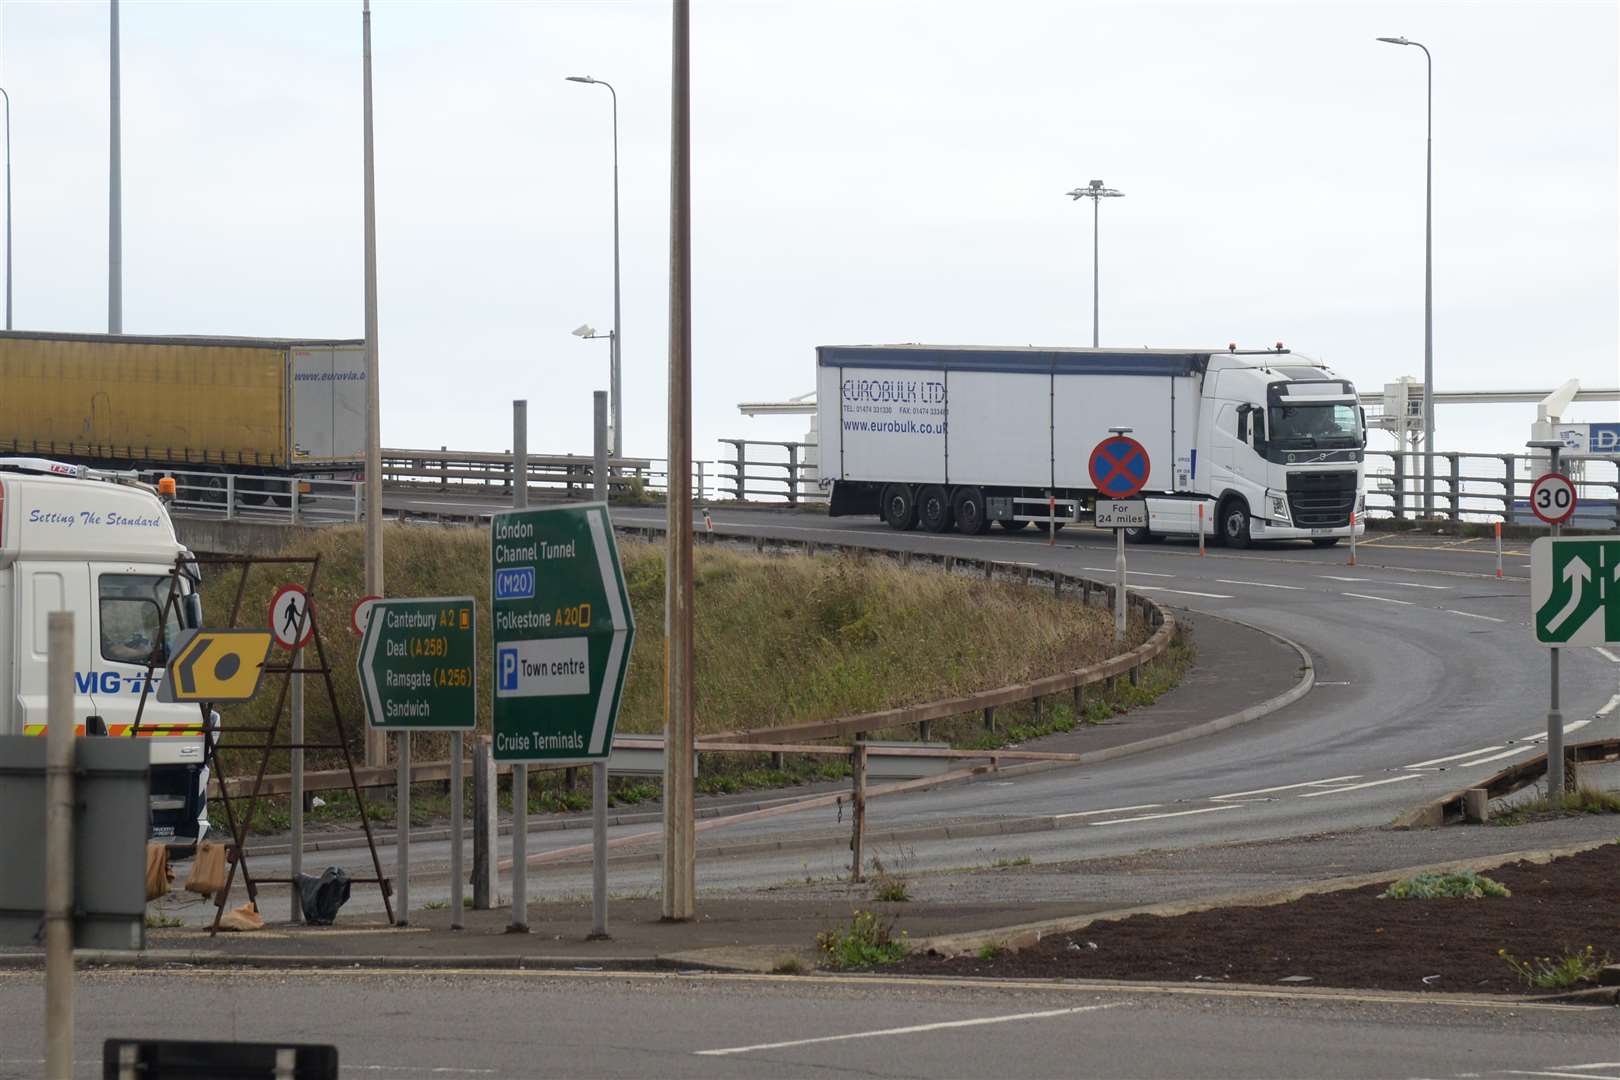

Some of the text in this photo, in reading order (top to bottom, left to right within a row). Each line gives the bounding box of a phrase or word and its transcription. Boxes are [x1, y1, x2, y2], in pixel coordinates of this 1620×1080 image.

[843, 380, 945, 404] EUROBULK LTD
[1537, 488, 1570, 508] 30
[29, 509, 161, 527] Setting The Standard
[1098, 513, 1143, 523] 24 miles
[1112, 504, 1129, 513] For
[496, 520, 533, 540] London
[496, 539, 576, 563] Channel Tunnel
[497, 571, 533, 595] (M20)
[387, 610, 437, 631] Canterbury
[496, 610, 552, 631] Folkestone
[386, 639, 408, 656] Deal
[503, 653, 515, 687] P
[521, 657, 585, 677] Town centre
[386, 669, 431, 690] Ramsgate
[386, 698, 430, 717] Sandwich
[496, 729, 584, 751] Cruise Terminals
